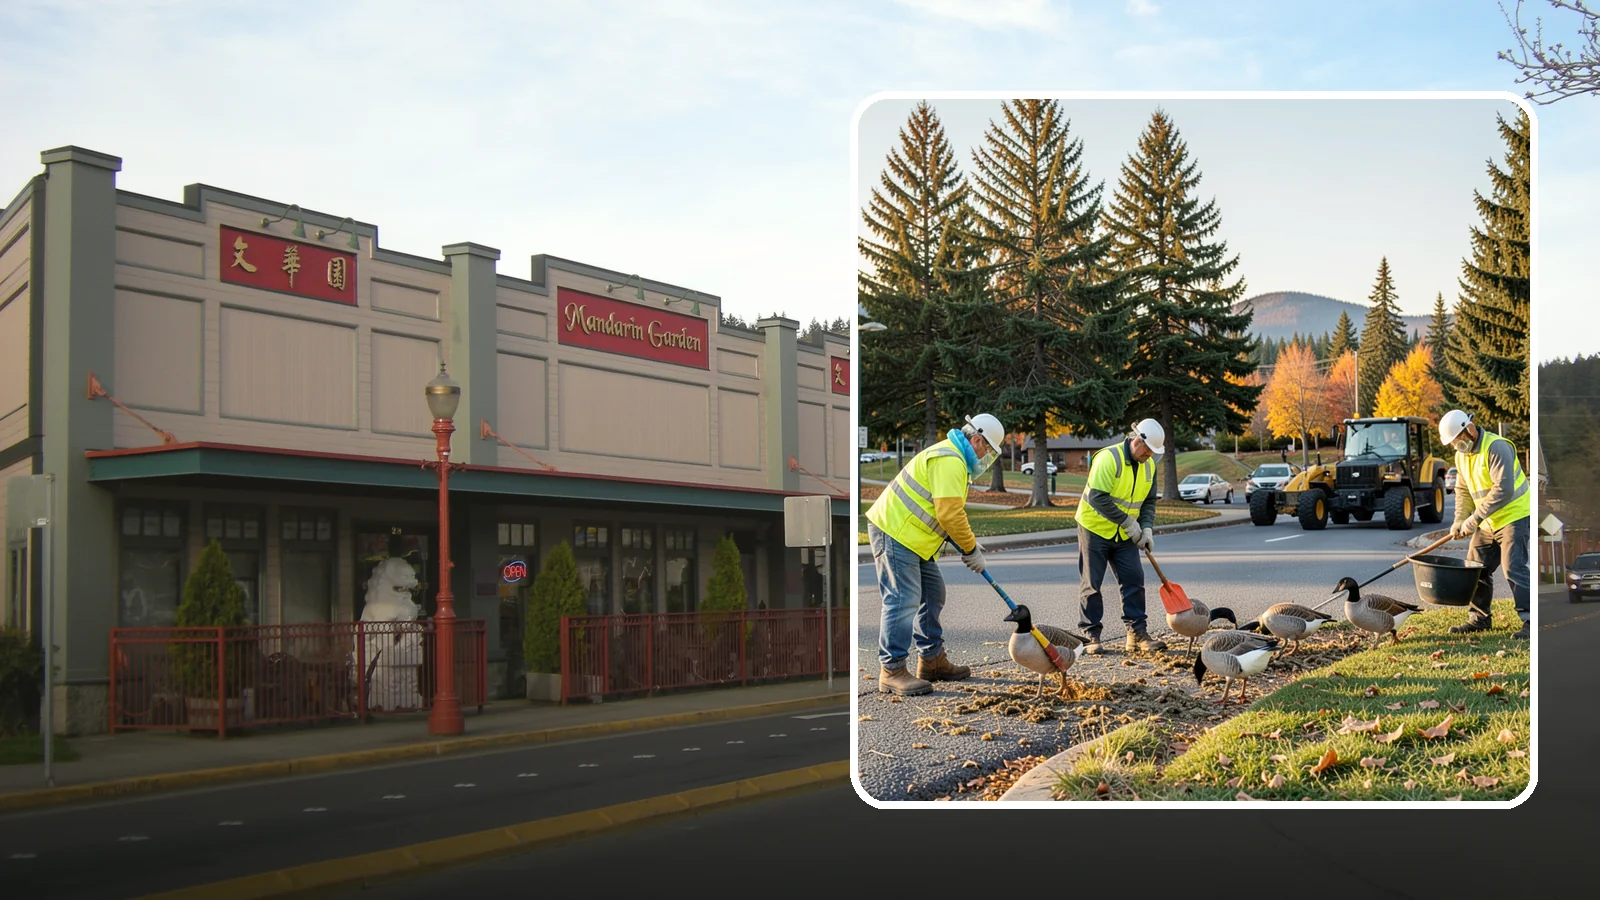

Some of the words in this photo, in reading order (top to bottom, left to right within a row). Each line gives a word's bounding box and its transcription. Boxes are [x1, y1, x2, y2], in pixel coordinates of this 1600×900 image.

[230, 235, 346, 292] 文華園
[564, 302, 644, 341] Mandarin
[647, 320, 702, 352] Garden
[503, 565, 527, 578] OPEN
